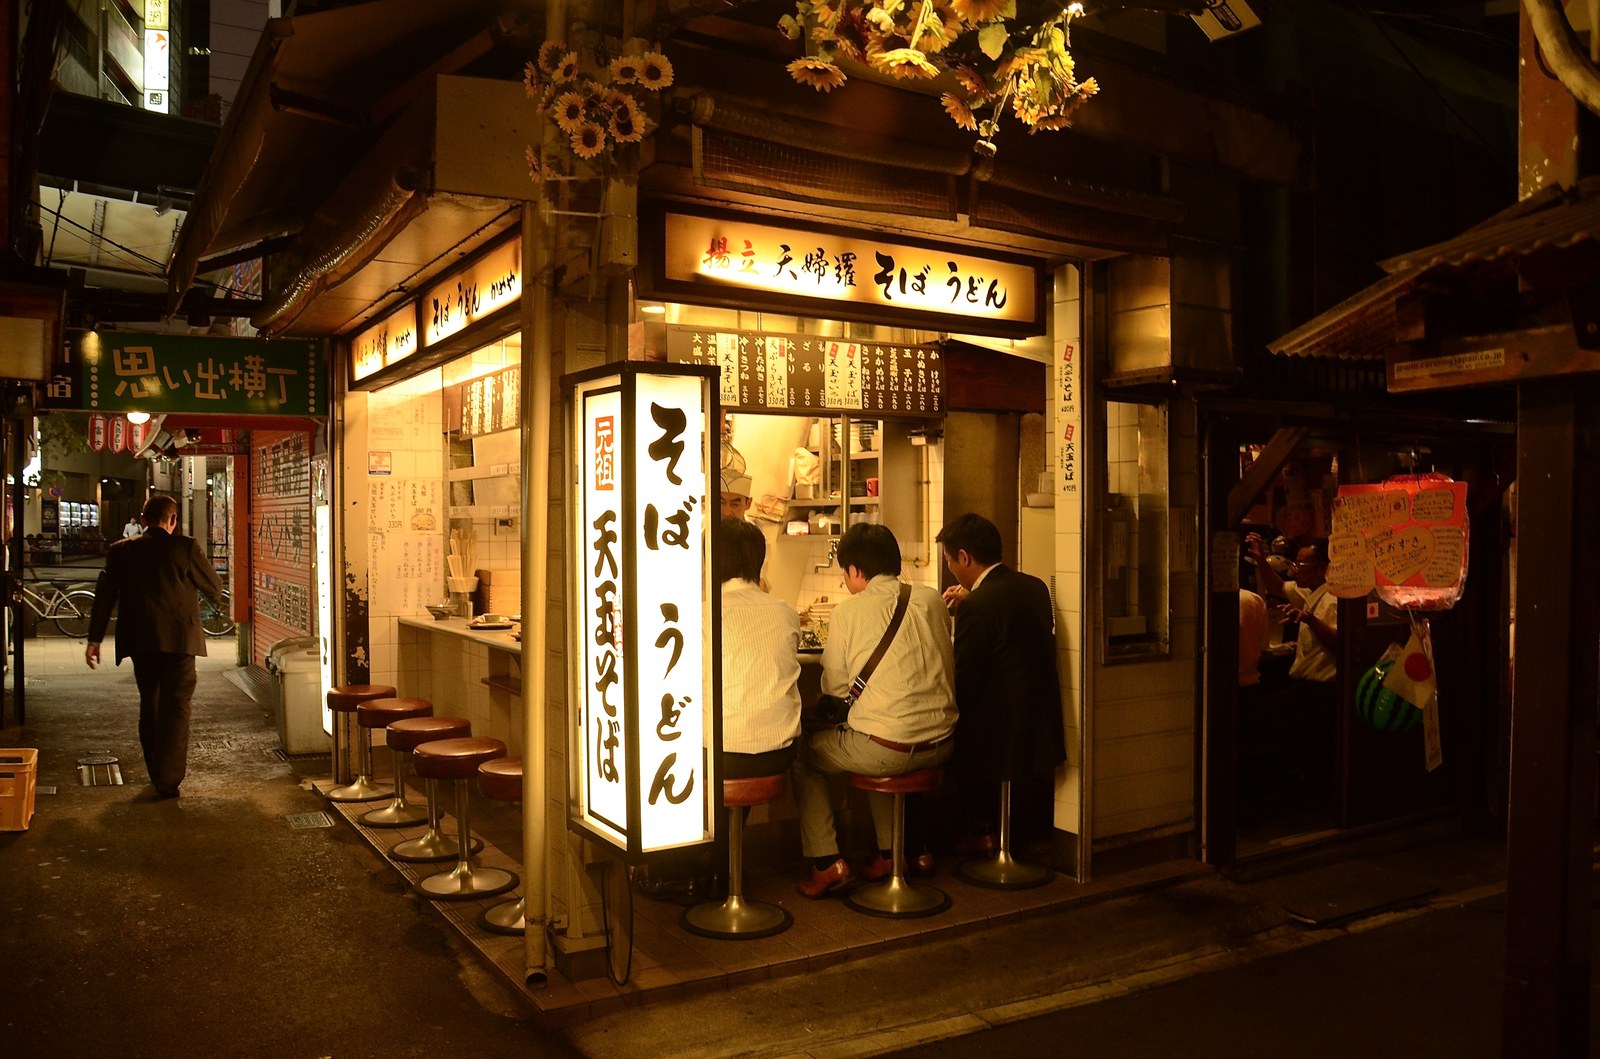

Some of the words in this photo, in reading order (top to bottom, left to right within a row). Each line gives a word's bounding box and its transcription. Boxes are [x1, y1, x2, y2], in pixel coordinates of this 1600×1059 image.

[703, 236, 759, 274] 揚立
[773, 244, 858, 287] 天婦羅
[873, 250, 932, 300] そば
[946, 261, 1007, 309] うどん
[432, 293, 450, 336] そば
[457, 281, 480, 319] うどん
[490, 269, 515, 301] かめや
[112, 346, 297, 404] 思い出横丁
[722, 354, 735, 393] 天玉そば
[739, 336, 749, 380] 冷しきつね
[755, 337, 765, 381] 冷したぬき
[787, 339, 796, 374] 大もり
[803, 341, 811, 372] ざる
[818, 341, 825, 372] もり
[862, 345, 870, 375] きつね
[875, 346, 884, 375] わかめ
[903, 349, 912, 378] 玉子
[917, 349, 925, 379] たぬき
[930, 350, 939, 379] かけ
[777, 375, 785, 396] そば
[846, 360, 857, 397] 天玉そば
[595, 420, 614, 487] 元祖
[1064, 443, 1075, 481] 天玉そば
[644, 401, 698, 551] そば
[593, 509, 621, 784] 天玉そば
[648, 602, 695, 806] うどん
